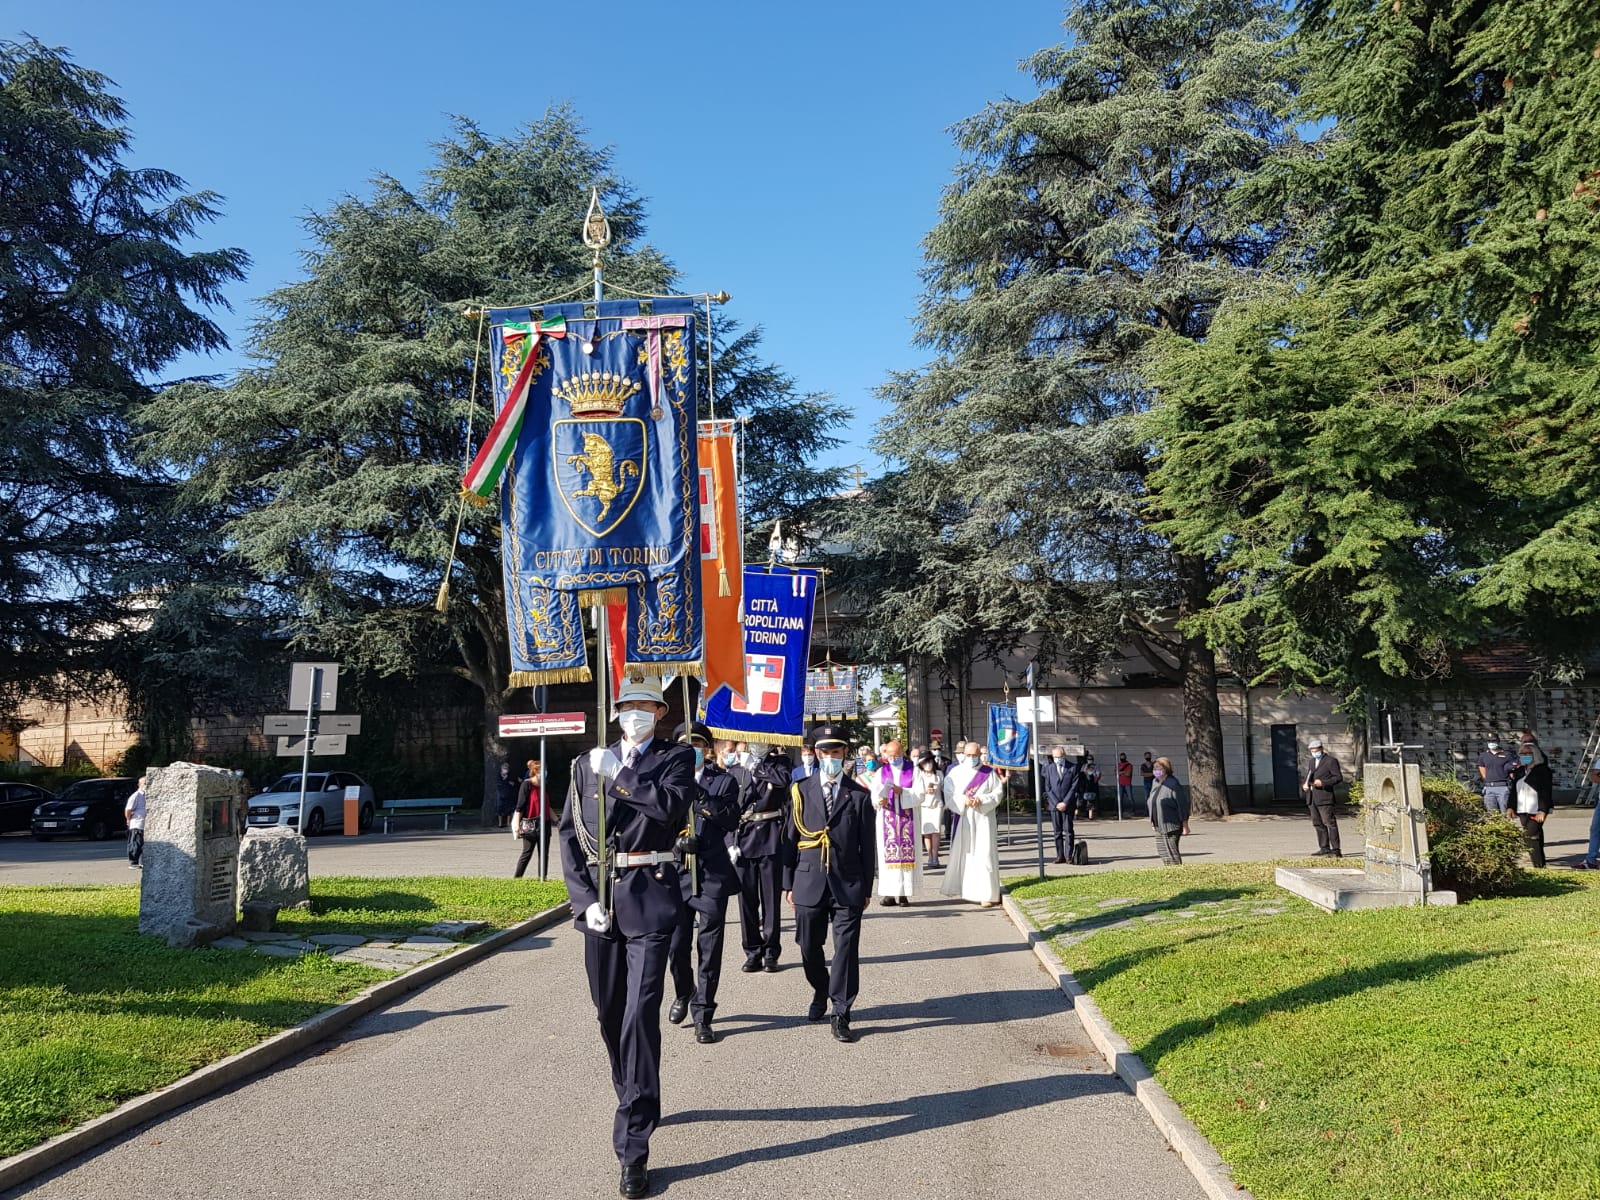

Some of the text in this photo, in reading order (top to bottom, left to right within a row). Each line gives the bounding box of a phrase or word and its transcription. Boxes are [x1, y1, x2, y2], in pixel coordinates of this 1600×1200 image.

[589, 547, 602, 565] DI
[609, 546, 670, 565] TORINO
[751, 597, 778, 612] CITTÀ
[745, 614, 804, 630] ROPOLITANA
[750, 630, 787, 645] TORINO
